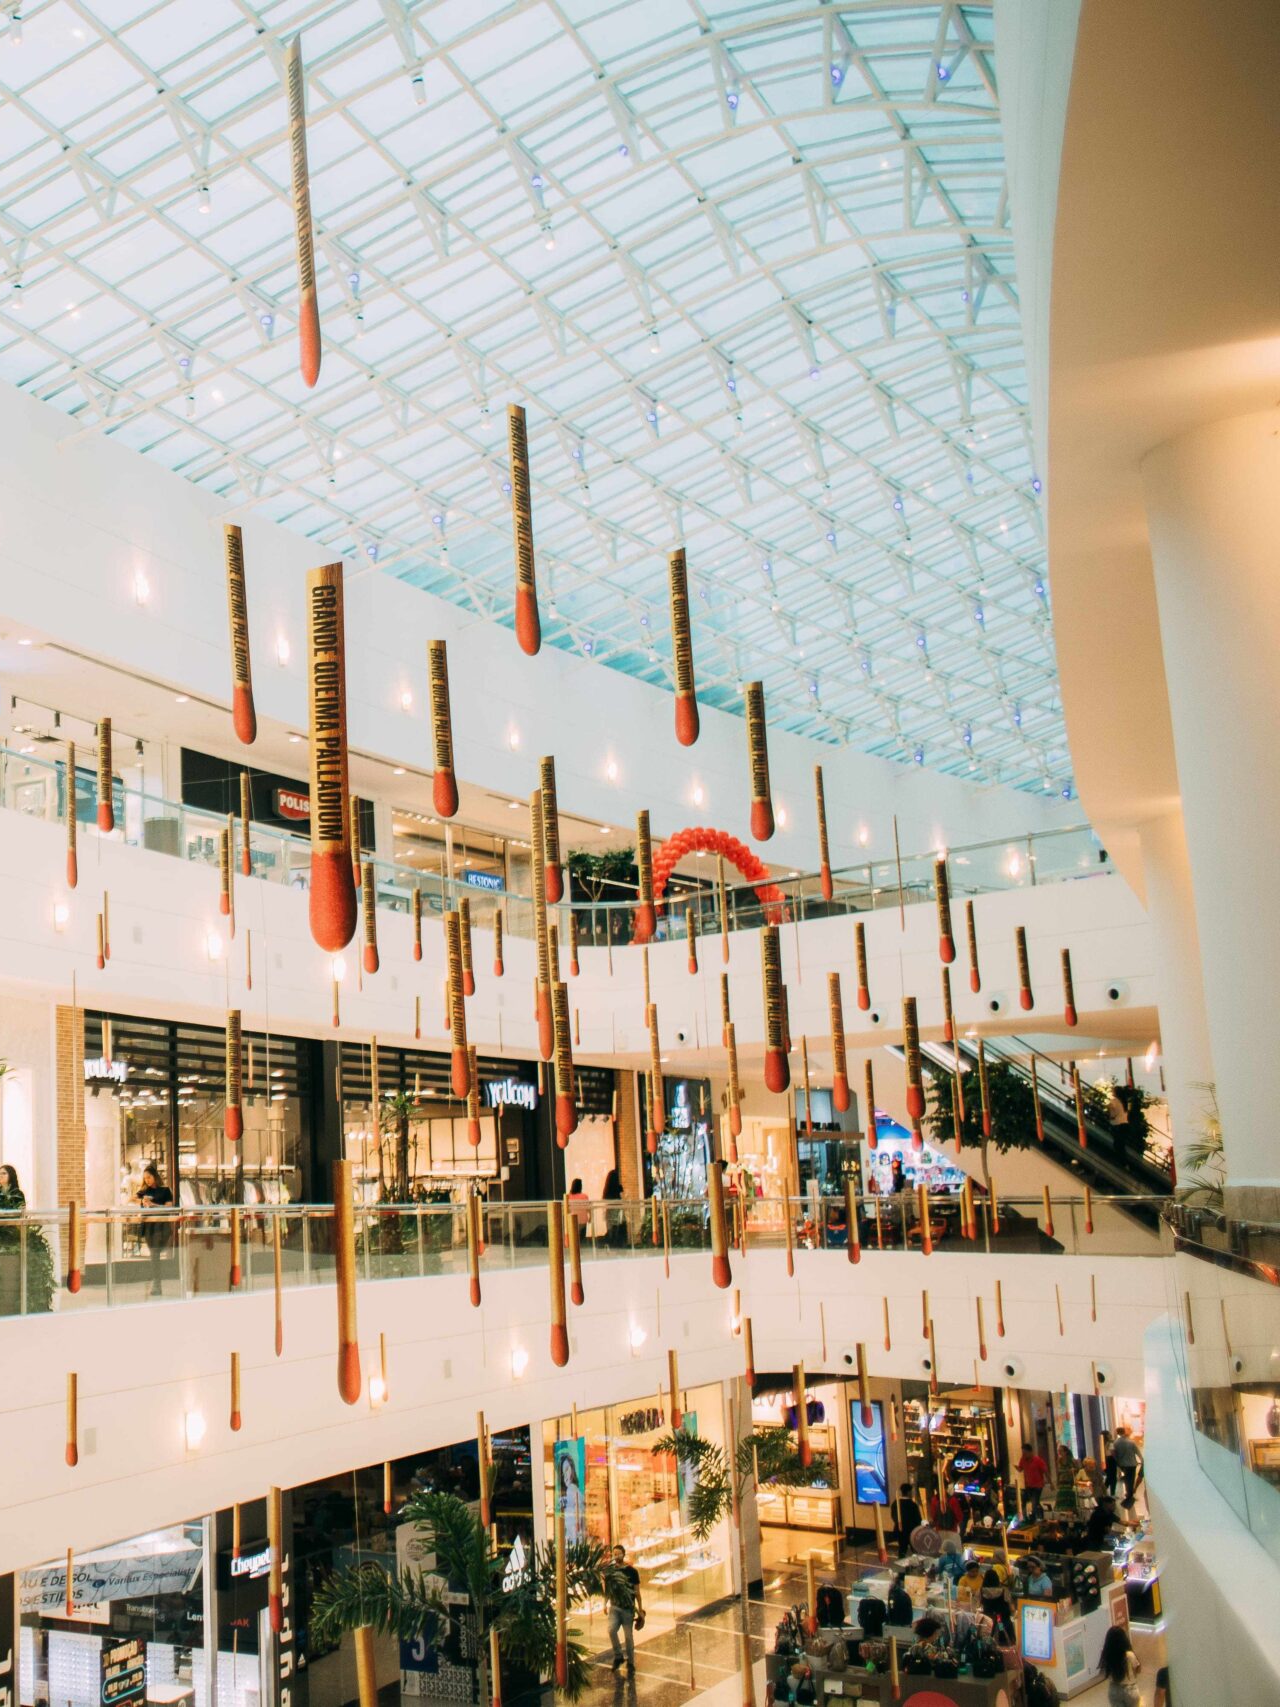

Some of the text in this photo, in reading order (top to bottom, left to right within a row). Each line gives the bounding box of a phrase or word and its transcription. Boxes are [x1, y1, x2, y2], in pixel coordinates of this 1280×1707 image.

[510, 415, 533, 586] GRANDE QUEIMA PALLADIUM
[227, 534, 249, 684] GRANDE QUEIMA PALLADIUM
[670, 560, 691, 692] GRANDE QUEIMA PALLADIUM
[312, 585, 342, 841] GRANDE QUEIMA PALLADIUM
[430, 648, 450, 769] GRANDE QUEIMA PALLADIUM
[279, 794, 310, 813] POLIS
[448, 920, 465, 1046] GRANDE QUEIMA PALLADIUM
[554, 990, 566, 1018] GRANDE
[556, 1020, 568, 1047] QUEIMA
[764, 935, 783, 1047] GRANDE QUEIMA PALLADIUM
[559, 1049, 572, 1093] PALLADIUM
